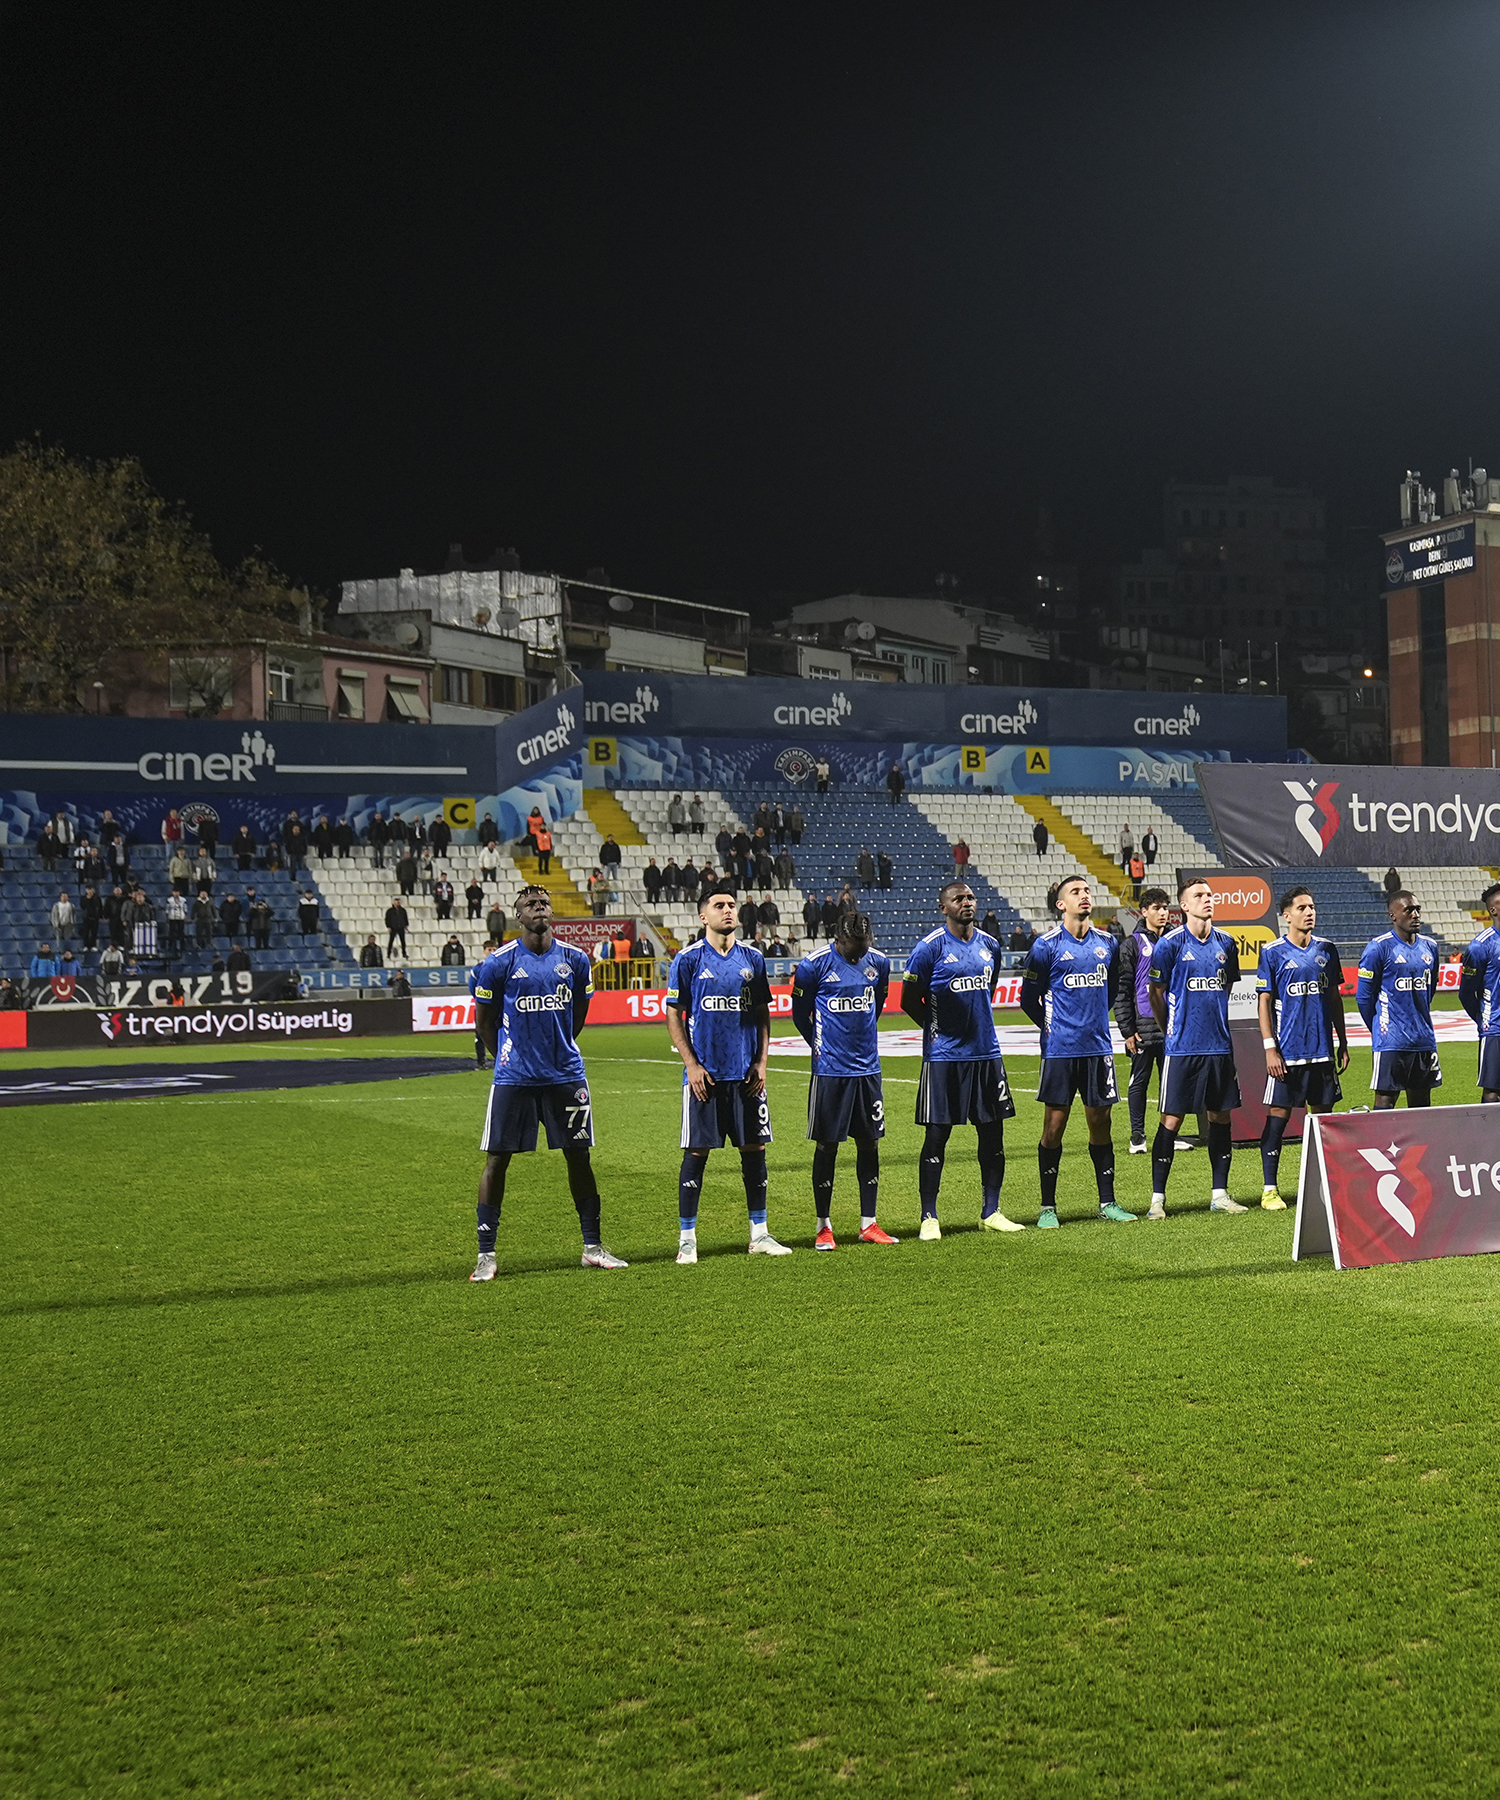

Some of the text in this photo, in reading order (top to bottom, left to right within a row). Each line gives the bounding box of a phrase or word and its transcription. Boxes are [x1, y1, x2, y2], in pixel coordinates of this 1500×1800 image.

[585, 701, 646, 724] ineR
[594, 742, 611, 761] B
[967, 751, 981, 768] B
[1030, 752, 1046, 769] A
[450, 803, 469, 824] C
[126, 1008, 352, 1037] trendyol süperLig
[1106, 1068, 1115, 1088] 4
[565, 1106, 591, 1129] 77
[758, 1104, 769, 1125] 9
